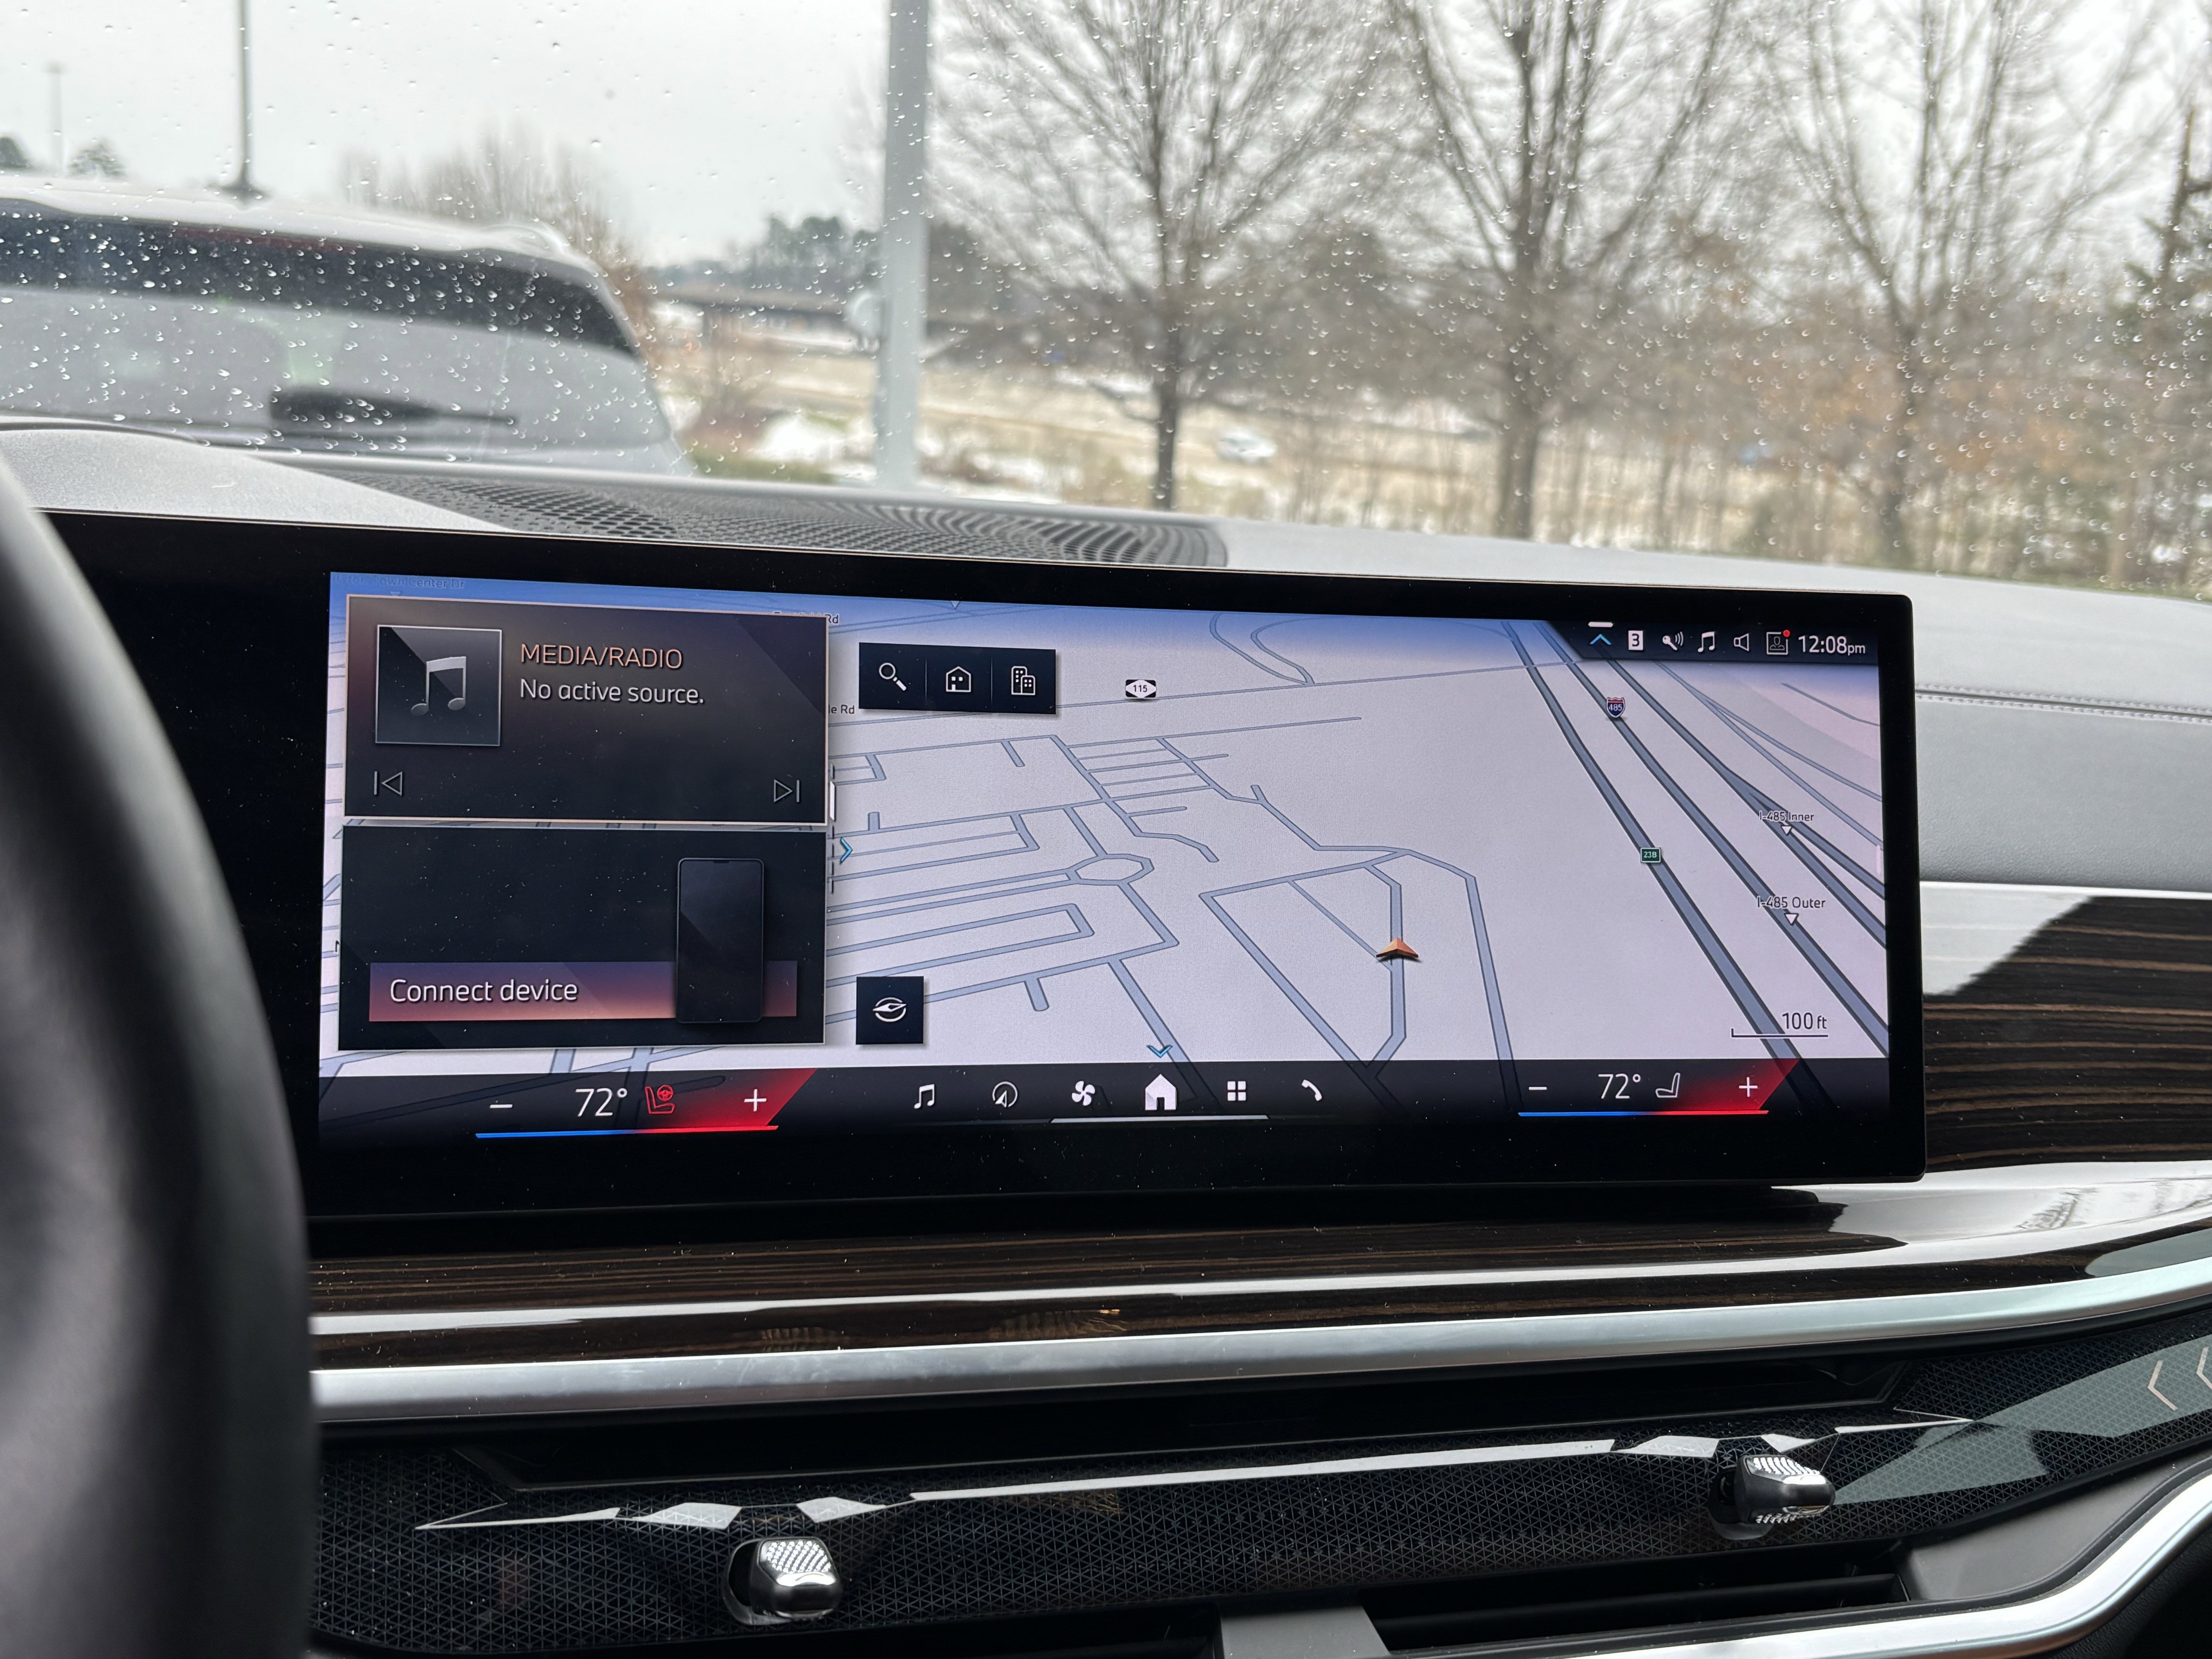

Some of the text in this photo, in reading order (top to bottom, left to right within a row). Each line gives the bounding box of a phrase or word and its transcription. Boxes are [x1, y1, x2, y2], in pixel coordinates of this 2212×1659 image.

[409, 577, 446, 588] Center
[452, 579, 464, 588] Dr
[1632, 633, 1640, 647] 3
[1798, 635, 1866, 656] 12:08pm
[521, 643, 682, 669] MEDIA/RADIO
[520, 678, 704, 704] No active source.
[1133, 684, 1148, 693] 115
[841, 704, 854, 714] Rd
[1608, 703, 1623, 711] 485
[1759, 811, 1814, 821] I-485 Inner
[1757, 896, 1826, 908] I-485 Outer
[390, 979, 578, 1002] Connect device
[1782, 1012, 1827, 1030] 100 ft
[1598, 1073, 1641, 1099] 72°
[575, 1087, 628, 1117] 72°
